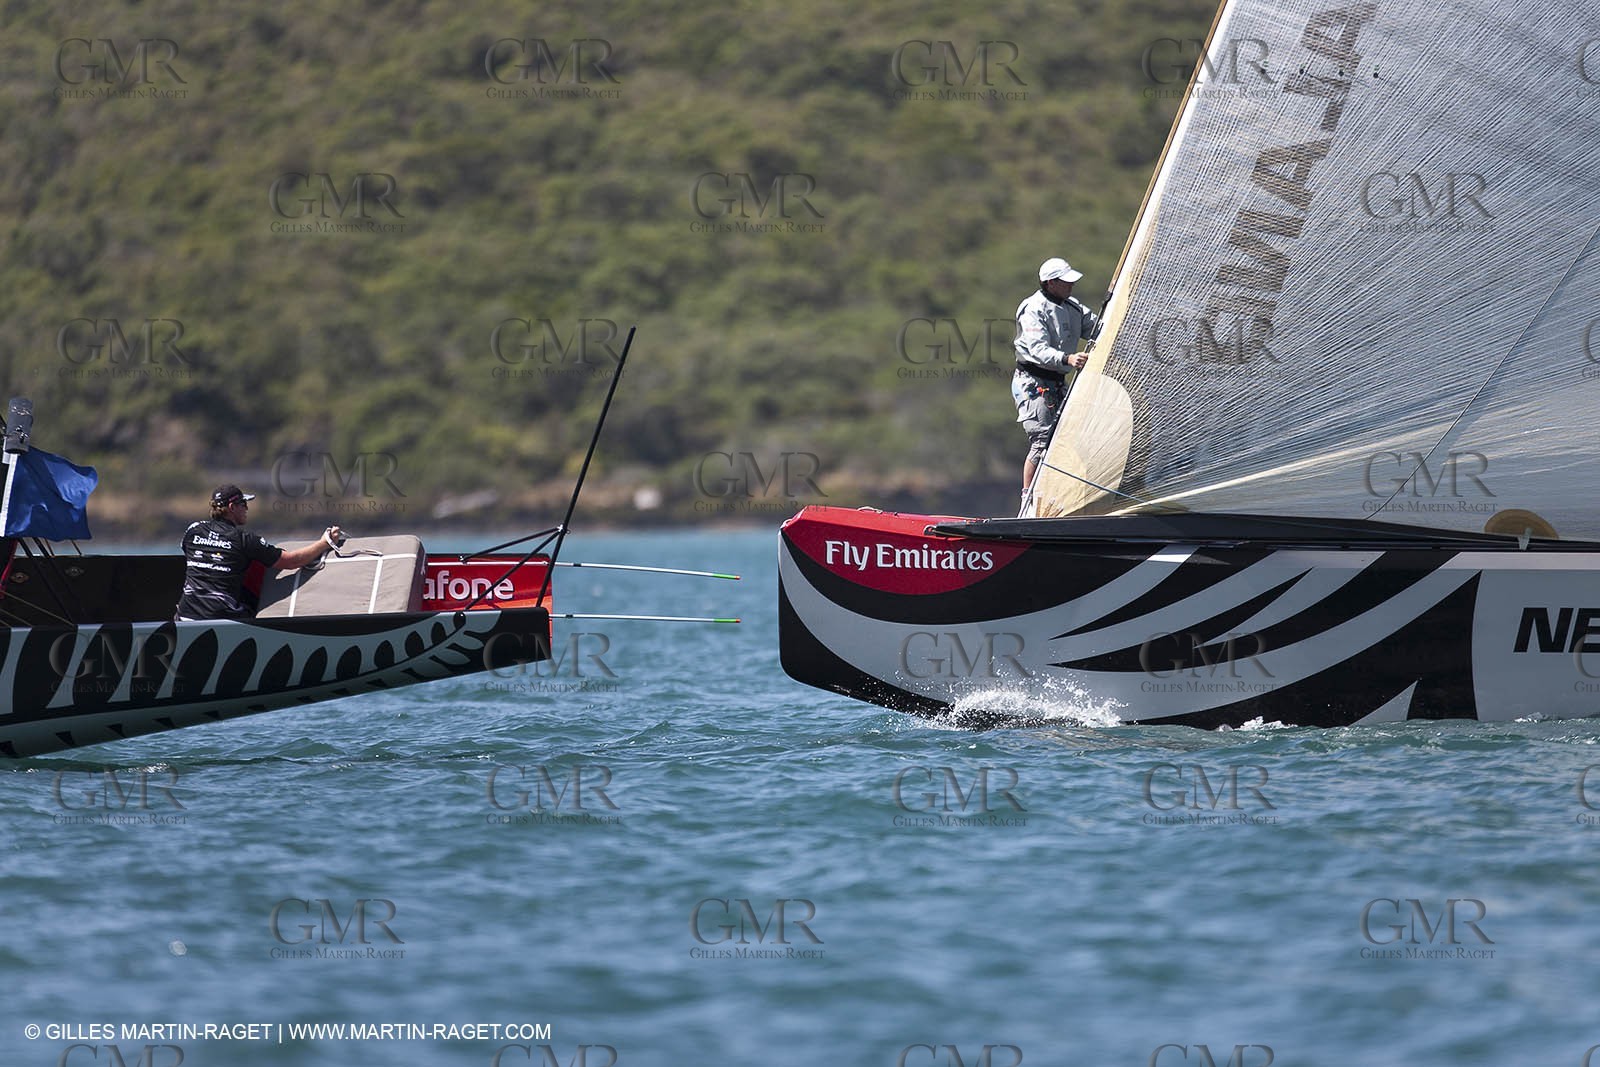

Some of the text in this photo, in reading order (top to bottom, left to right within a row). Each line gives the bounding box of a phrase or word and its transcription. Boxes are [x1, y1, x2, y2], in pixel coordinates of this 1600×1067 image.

[192, 535, 232, 549] Emirates
[825, 540, 994, 571] Fly Emirates
